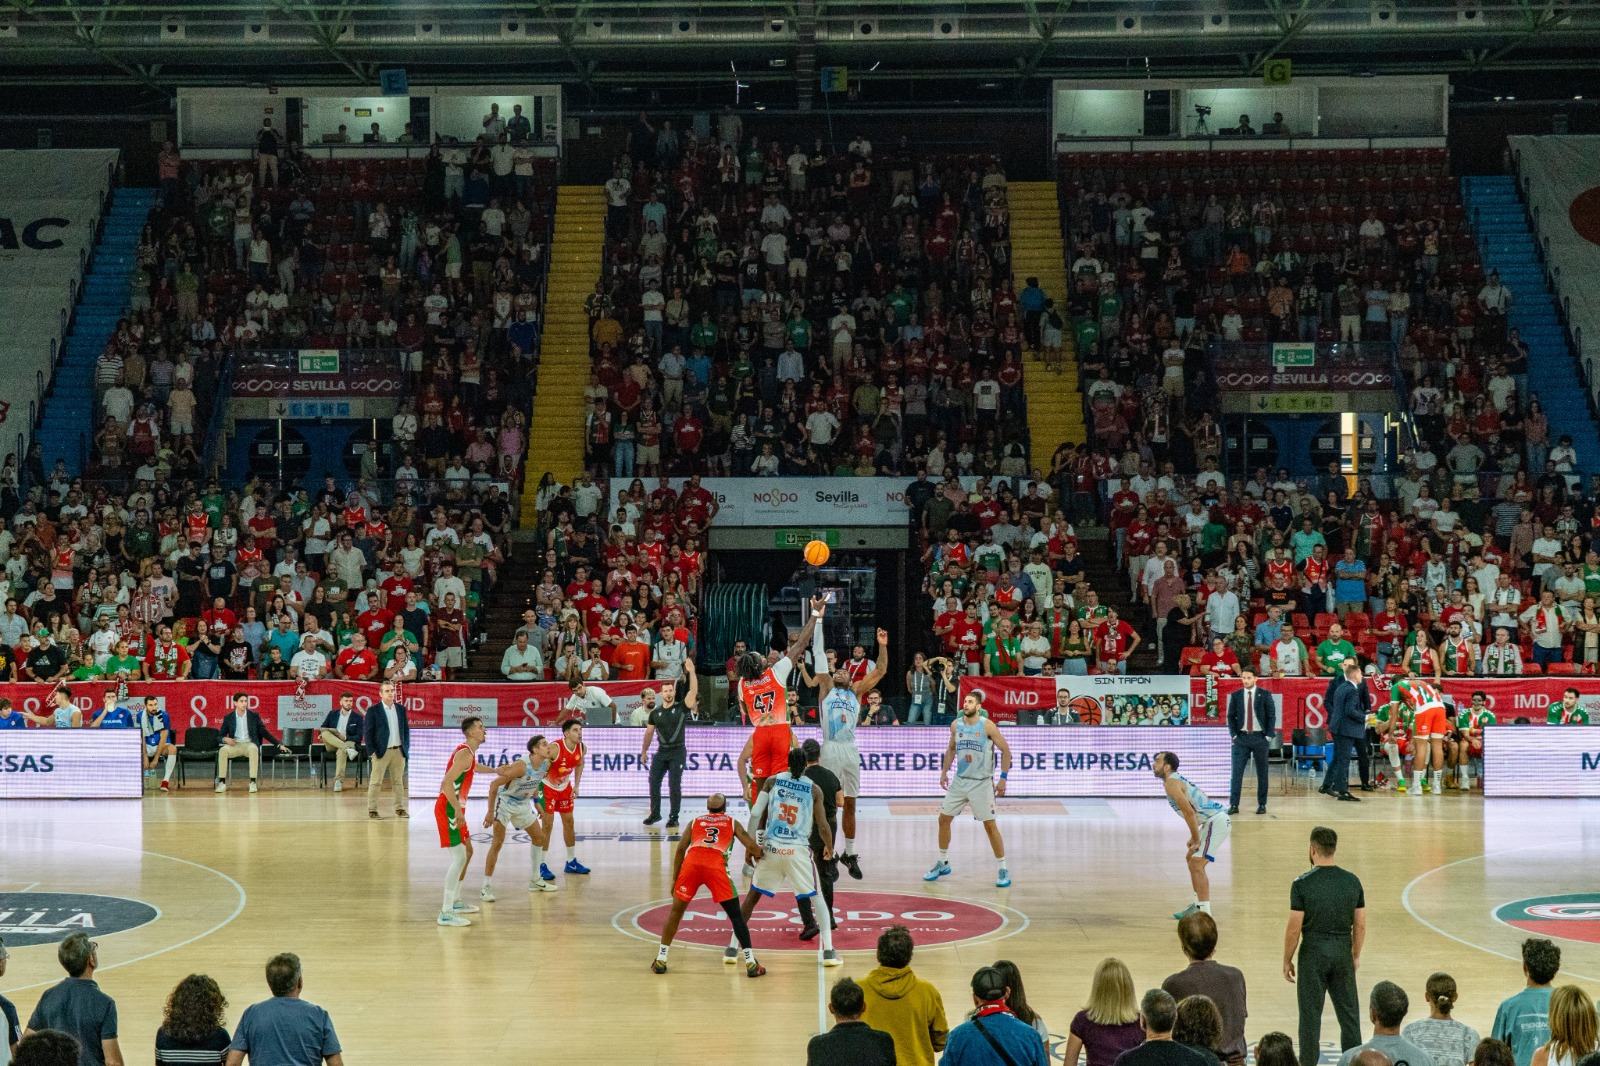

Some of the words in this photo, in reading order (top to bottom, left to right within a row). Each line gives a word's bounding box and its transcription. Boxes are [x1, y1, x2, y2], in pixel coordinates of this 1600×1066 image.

[1270, 64, 1286, 81] G
[292, 380, 346, 390] SEVILLA
[1272, 374, 1328, 384] SEVILLA
[815, 491, 859, 503] Sevilla
[1094, 677, 1114, 685] SIN
[1117, 676, 1151, 685] TAPÓN
[753, 690, 776, 714] 47
[1004, 690, 1038, 706] IMD
[1514, 694, 1550, 709] IMD
[705, 753, 733, 770] YA
[859, 753, 905, 770] ARTE
[1020, 753, 1045, 770] DE
[778, 802, 798, 825] 35
[703, 827, 718, 844] 3
